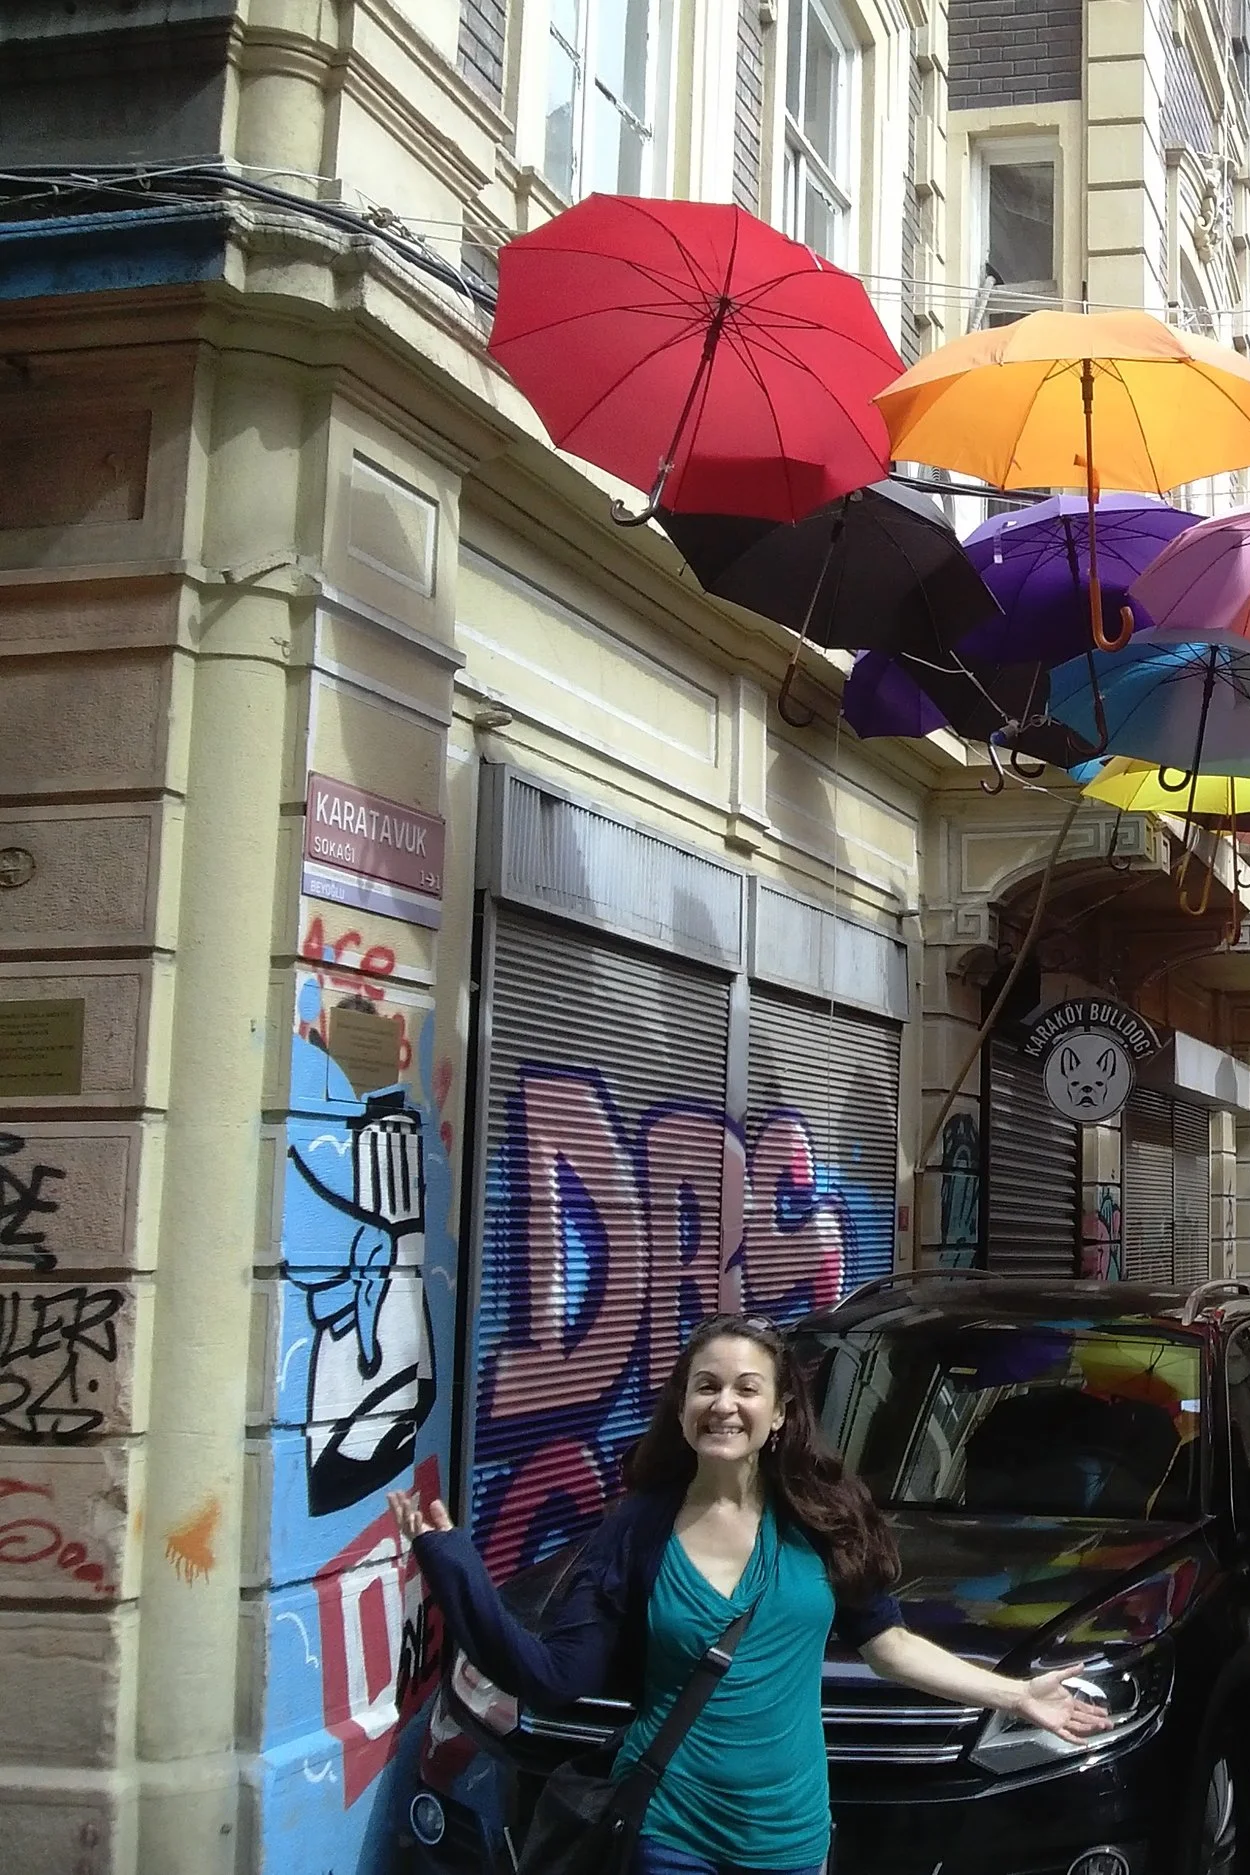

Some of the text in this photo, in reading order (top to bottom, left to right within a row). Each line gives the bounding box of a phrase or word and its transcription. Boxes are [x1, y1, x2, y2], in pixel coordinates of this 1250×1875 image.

[315, 791, 428, 858] KARATAVUK
[313, 835, 356, 864] SOKAĞI
[309, 879, 346, 900] BEYOĞLU
[1023, 1003, 1084, 1058] KARAKÖY
